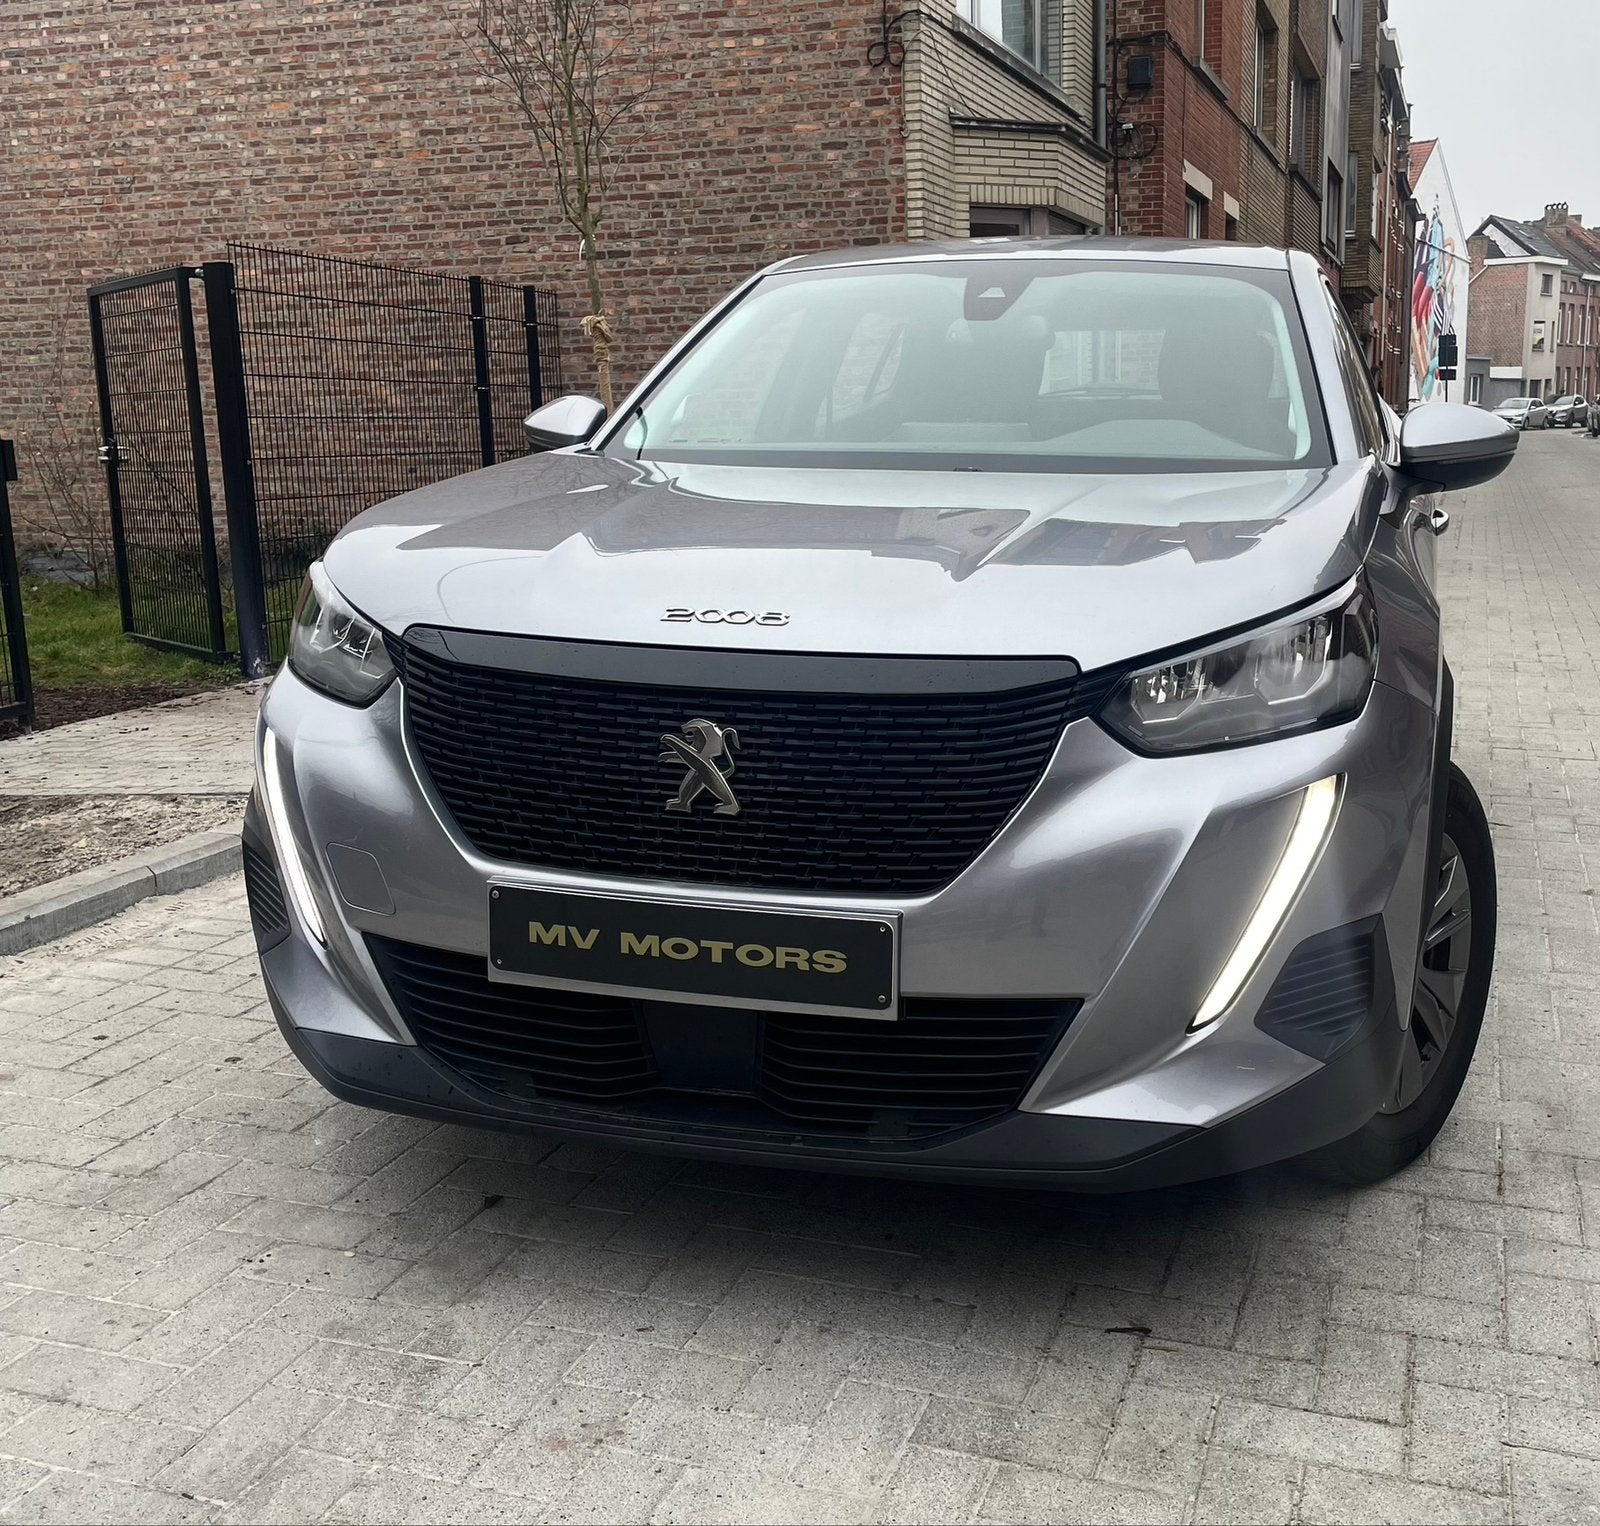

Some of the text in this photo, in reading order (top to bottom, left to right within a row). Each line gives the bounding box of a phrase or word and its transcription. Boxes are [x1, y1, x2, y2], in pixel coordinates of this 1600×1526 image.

[660, 606, 791, 626] 2008
[528, 921, 848, 974] MV MOTORS
